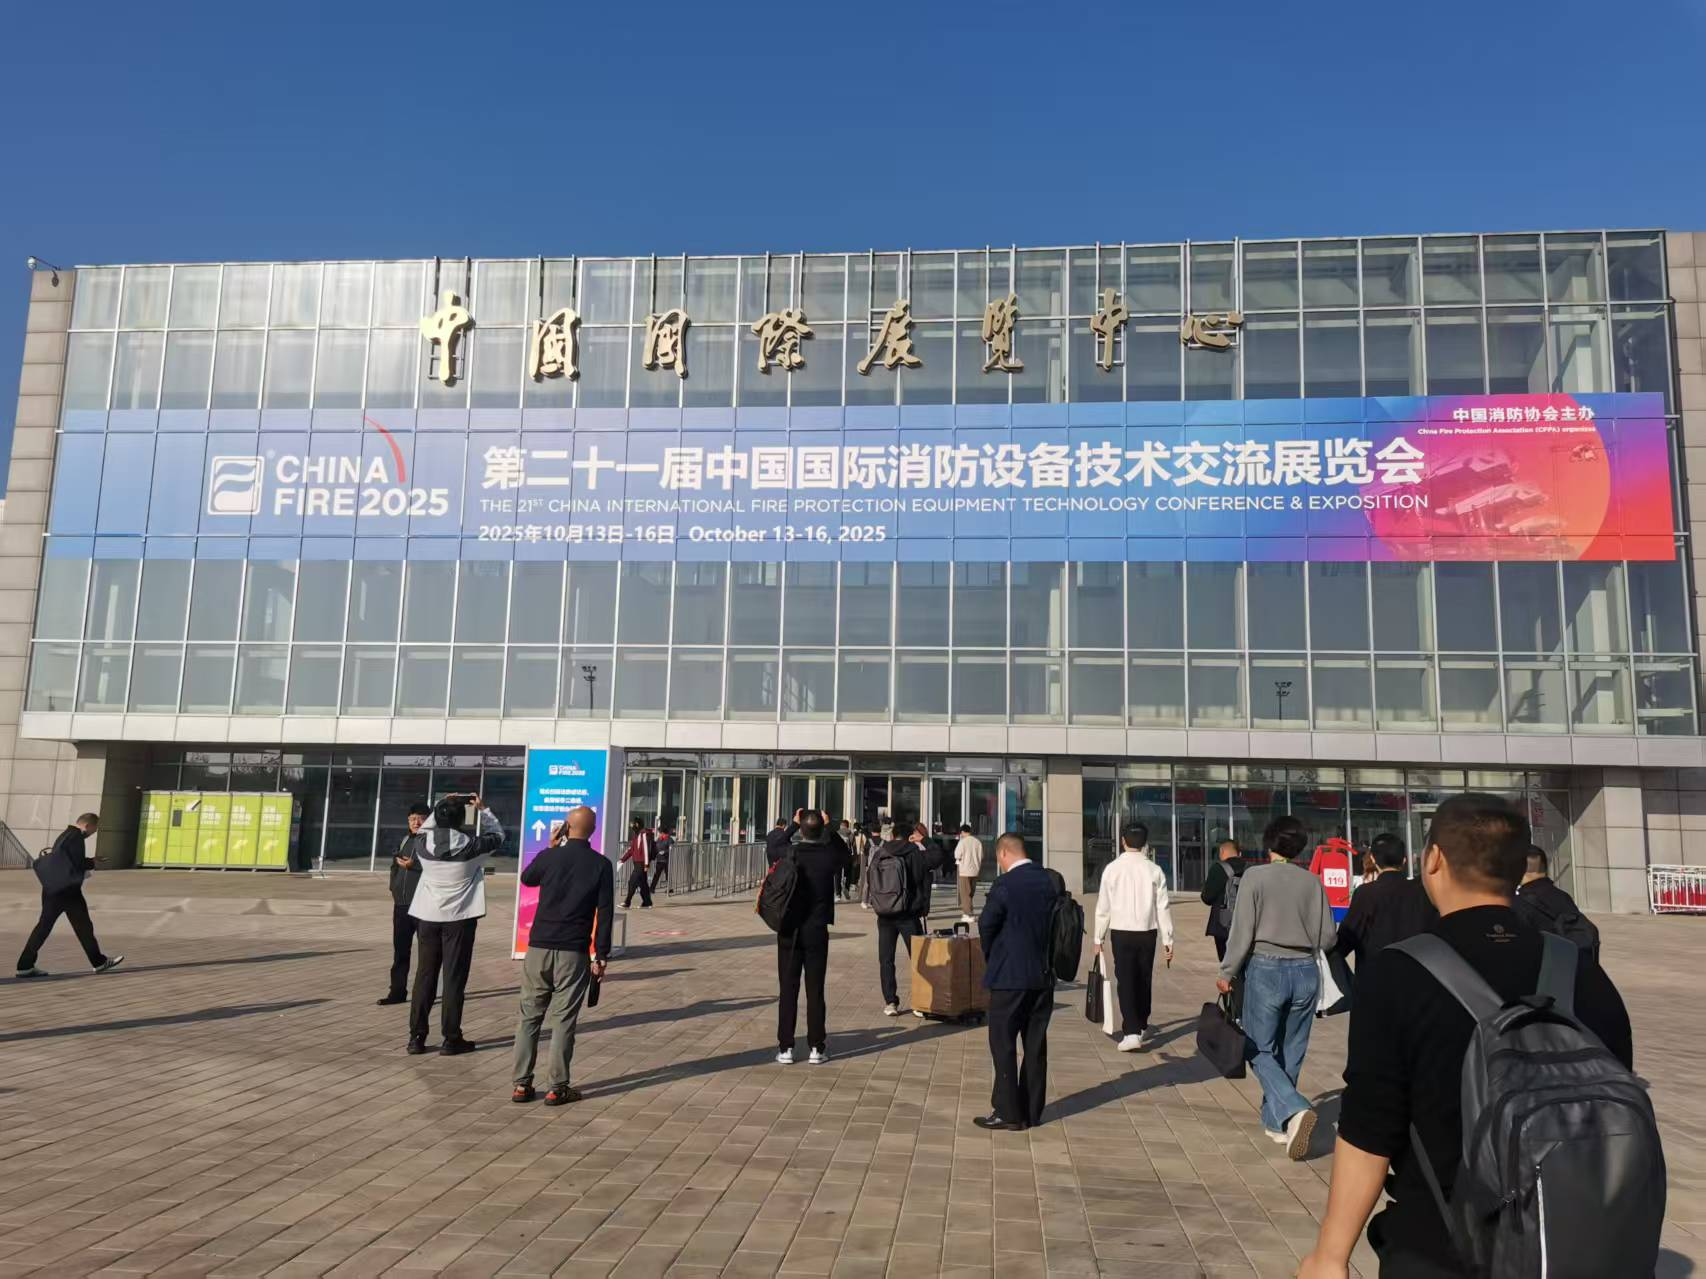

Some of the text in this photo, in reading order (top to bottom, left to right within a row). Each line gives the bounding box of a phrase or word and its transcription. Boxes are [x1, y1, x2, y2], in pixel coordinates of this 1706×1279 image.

[1453, 406, 1595, 423] 中国消防协会主办
[275, 455, 389, 483] CHINA
[481, 436, 1425, 490] 第二十一届中国国际消防设备技术交流展览会
[479, 499, 512, 513] THE
[548, 499, 601, 513] CHINA
[607, 499, 745, 513] INTERNATIONAL
[751, 499, 788, 513] FIRE
[794, 499, 906, 513] PROTECTION
[912, 498, 1016, 513] EQUIPMENT
[1022, 497, 1149, 512] TECHNOLOGY
[1155, 496, 1284, 511] CONFERENCE
[1290, 495, 1303, 510] &
[1309, 494, 1428, 510] EXPOSITION
[478, 525, 886, 544] 2025年10月13日-16日 October 13-16, 2025
